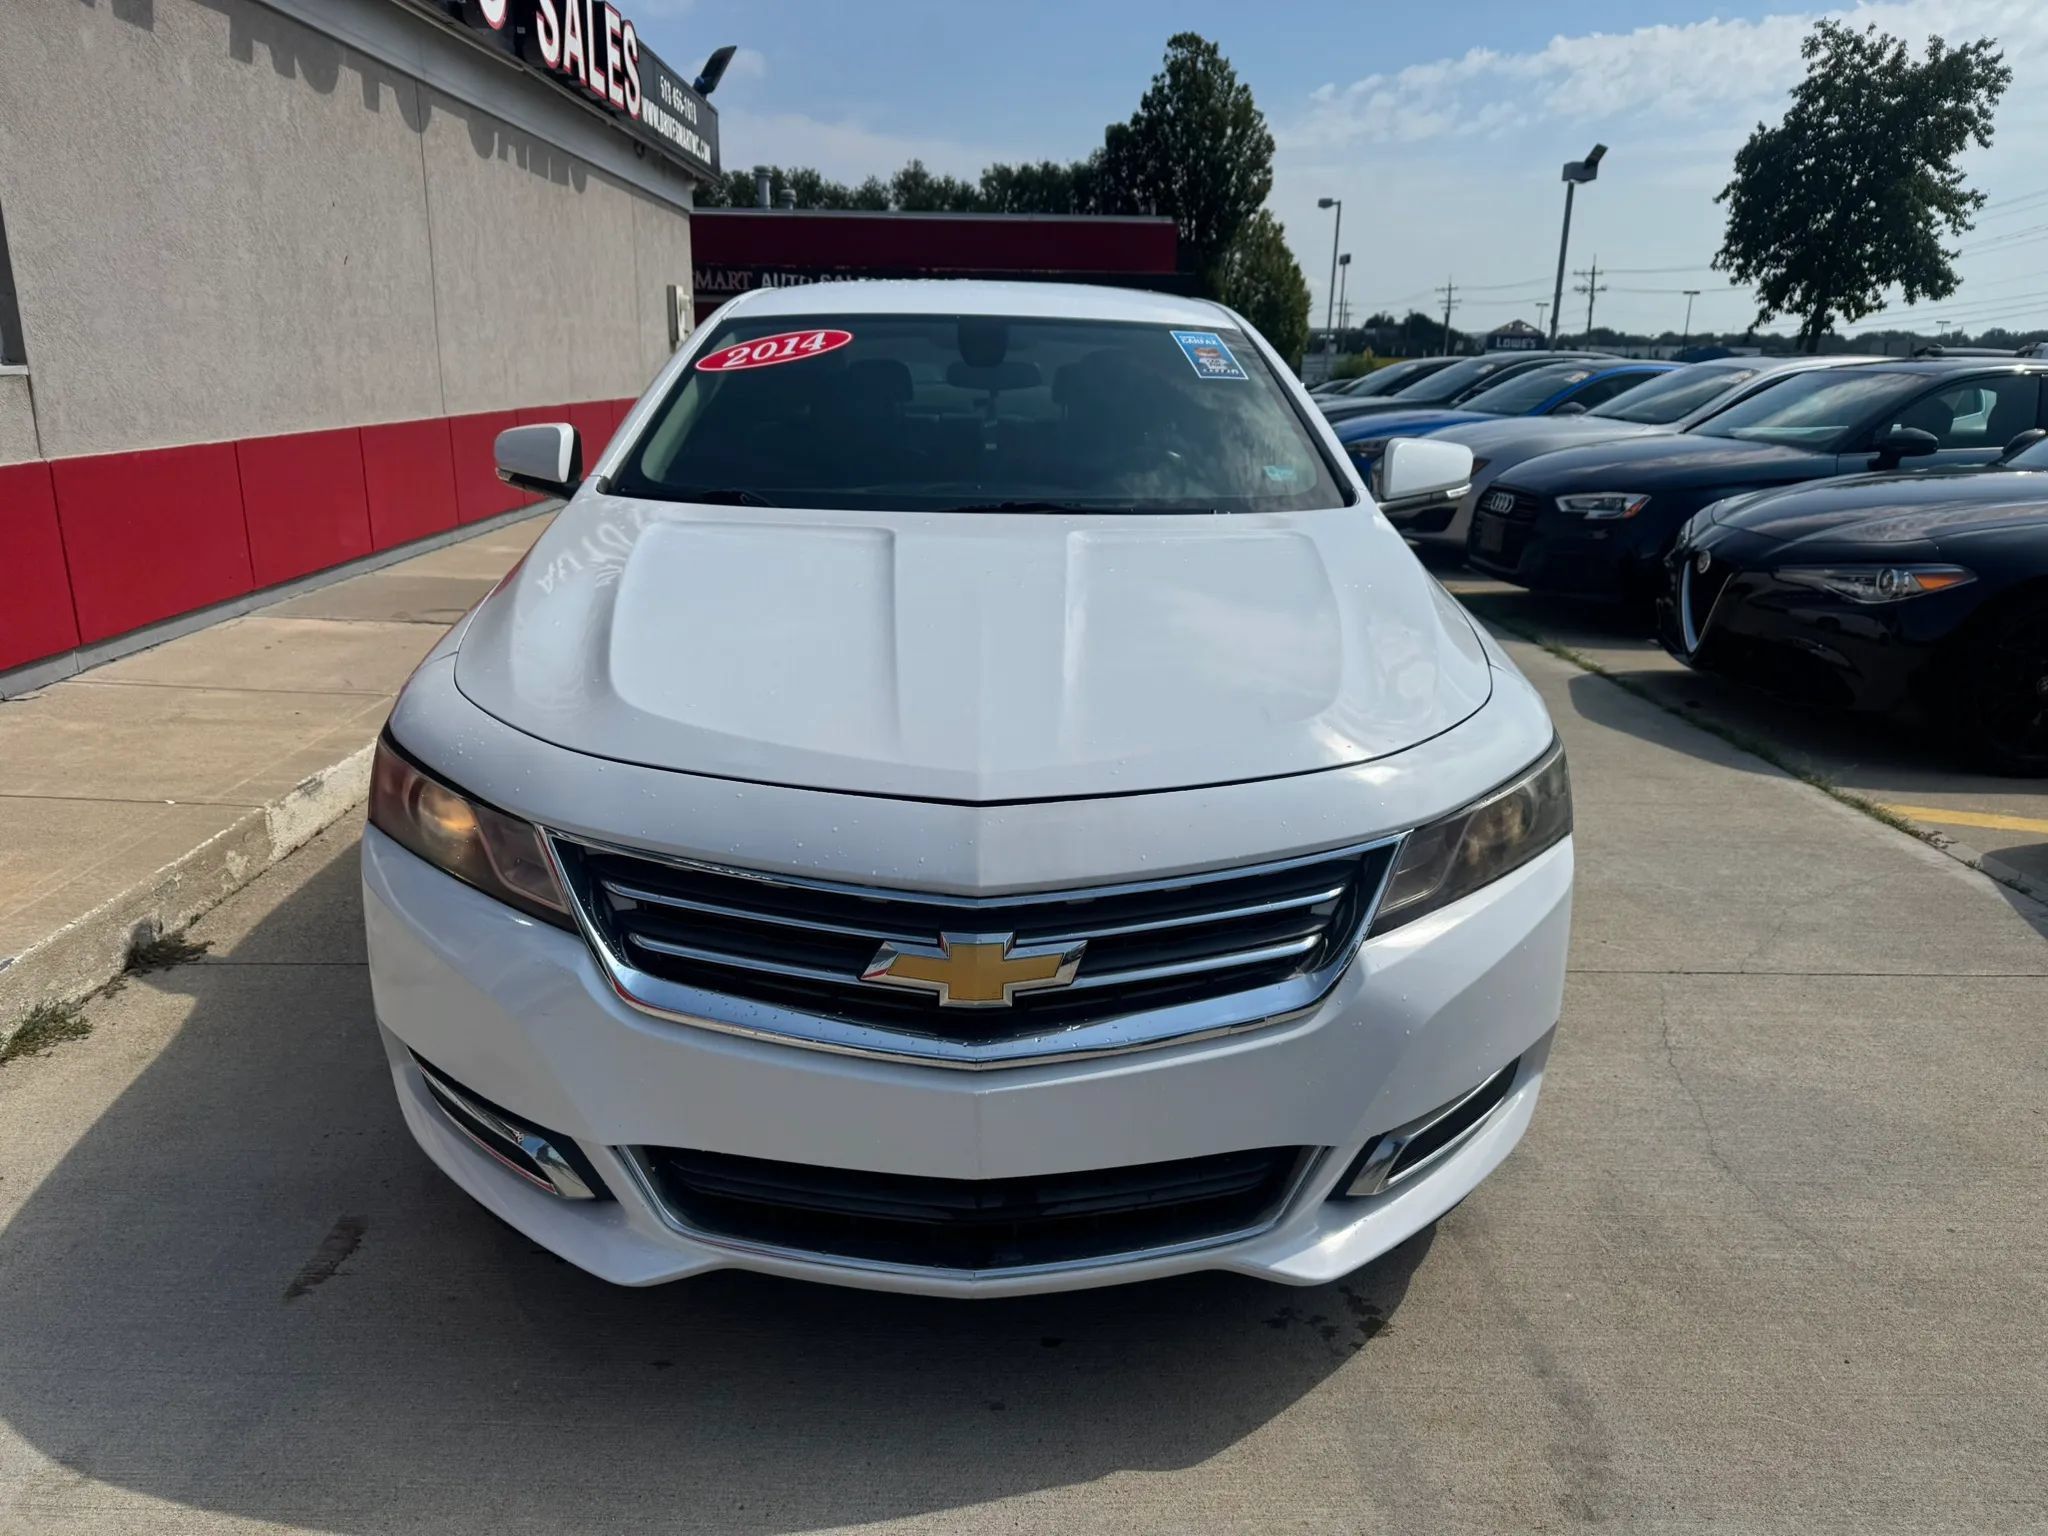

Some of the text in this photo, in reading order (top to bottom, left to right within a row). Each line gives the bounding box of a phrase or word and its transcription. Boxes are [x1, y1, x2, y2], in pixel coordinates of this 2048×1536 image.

[536, 0, 643, 120] SALES
[694, 268, 754, 290] MART
[721, 332, 827, 368] 2014
[1496, 335, 1537, 349] LOWE'S
